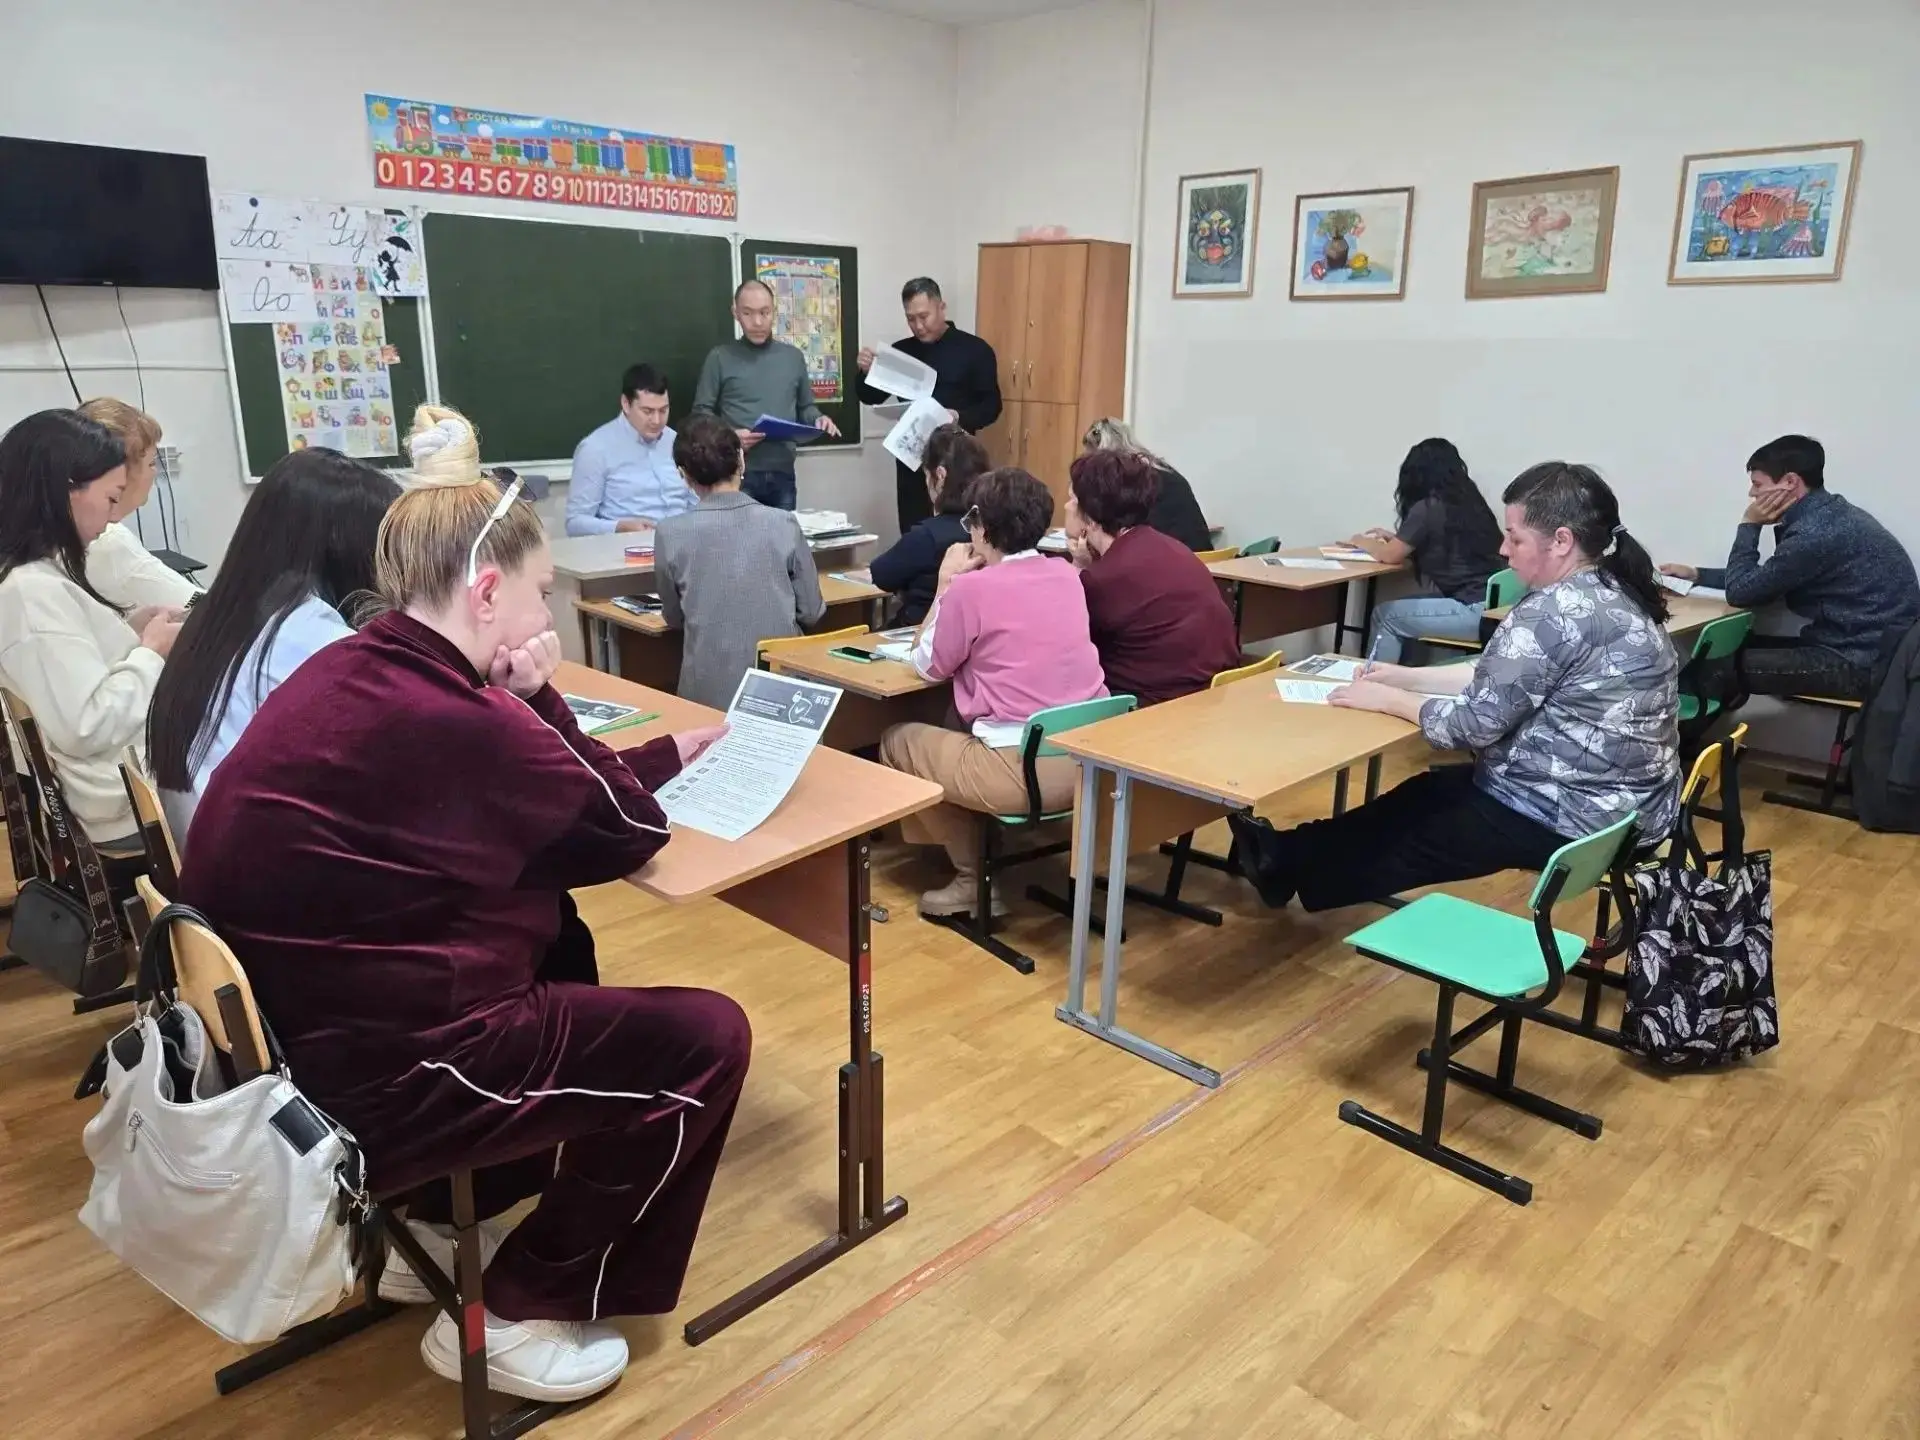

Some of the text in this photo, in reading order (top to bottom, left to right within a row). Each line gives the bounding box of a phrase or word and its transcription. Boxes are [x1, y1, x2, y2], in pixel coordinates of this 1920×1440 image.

[378, 158, 736, 217] 0 1 2 3 4 5 6 7 8 9 10 11 12 13 14 15 16 17 18 19 20
[230, 212, 282, 249] Аа
[253, 276, 291, 311] Оо
[344, 307, 355, 319] Н
[371, 308, 380, 320] О
[293, 334, 304, 345] П
[325, 389, 338, 400] Ш
[350, 388, 364, 401] Щ
